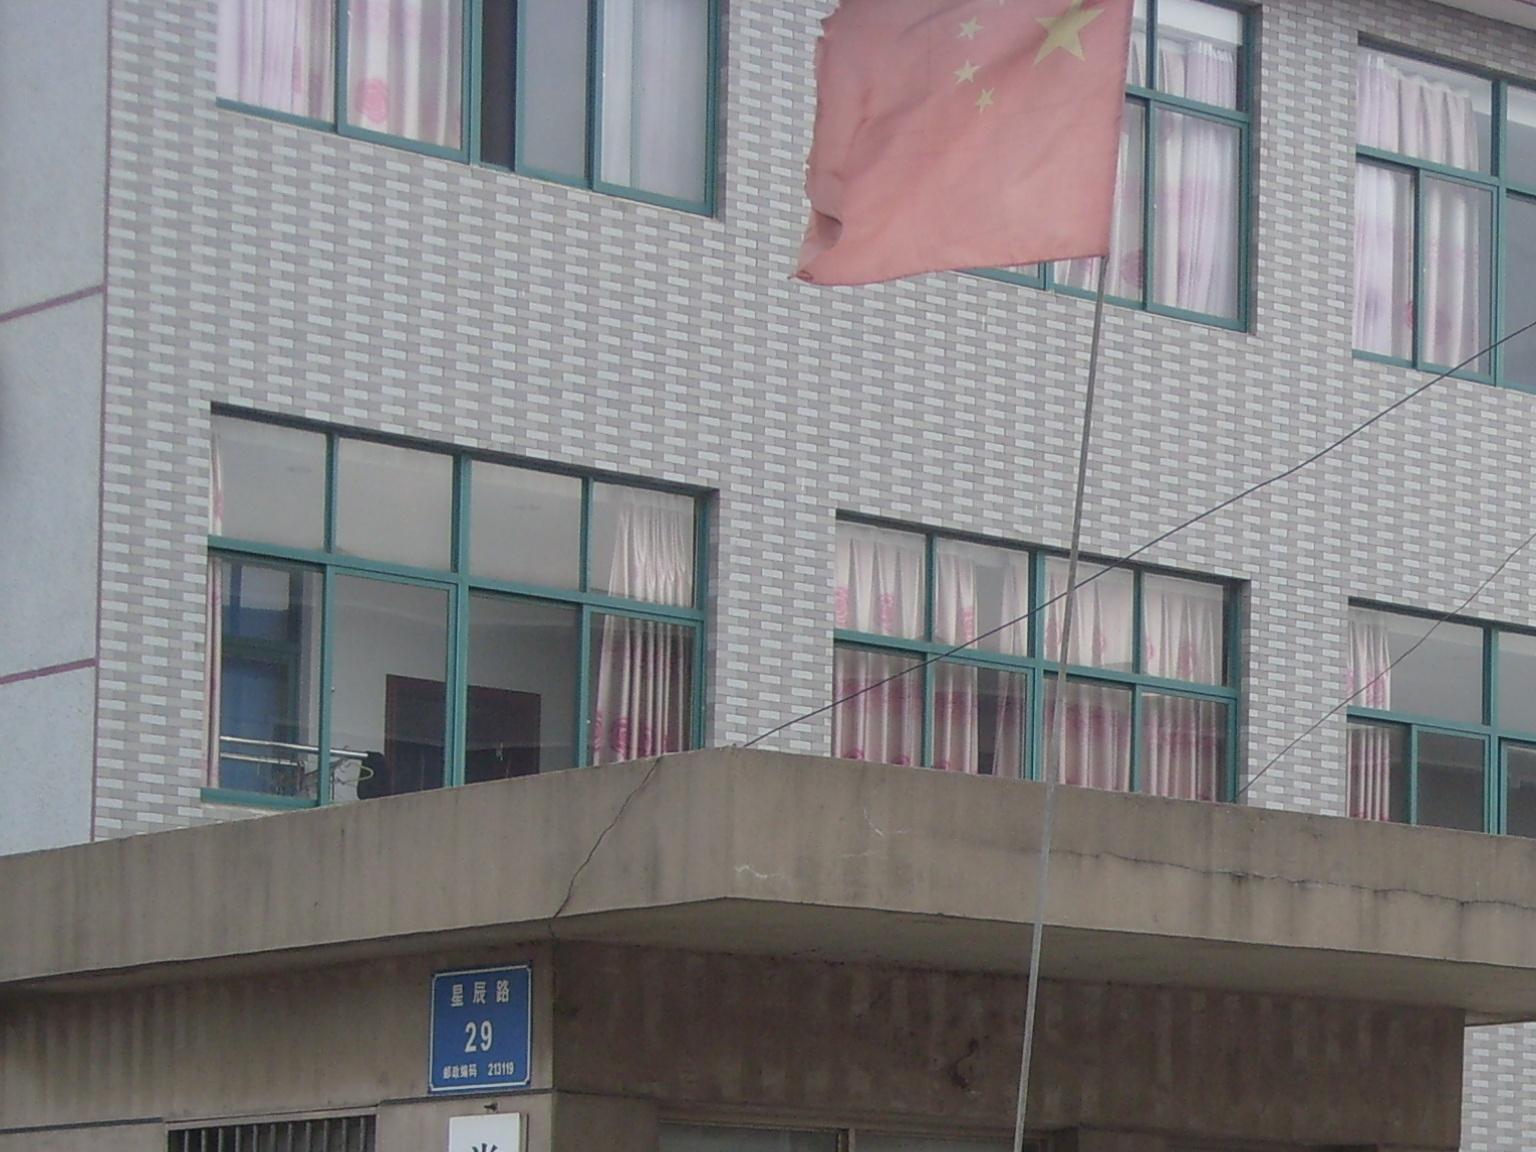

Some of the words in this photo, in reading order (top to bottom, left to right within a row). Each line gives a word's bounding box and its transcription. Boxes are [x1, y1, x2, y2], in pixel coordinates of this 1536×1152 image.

[451, 980, 509, 1006] 星辰路
[464, 1020, 493, 1053] 29
